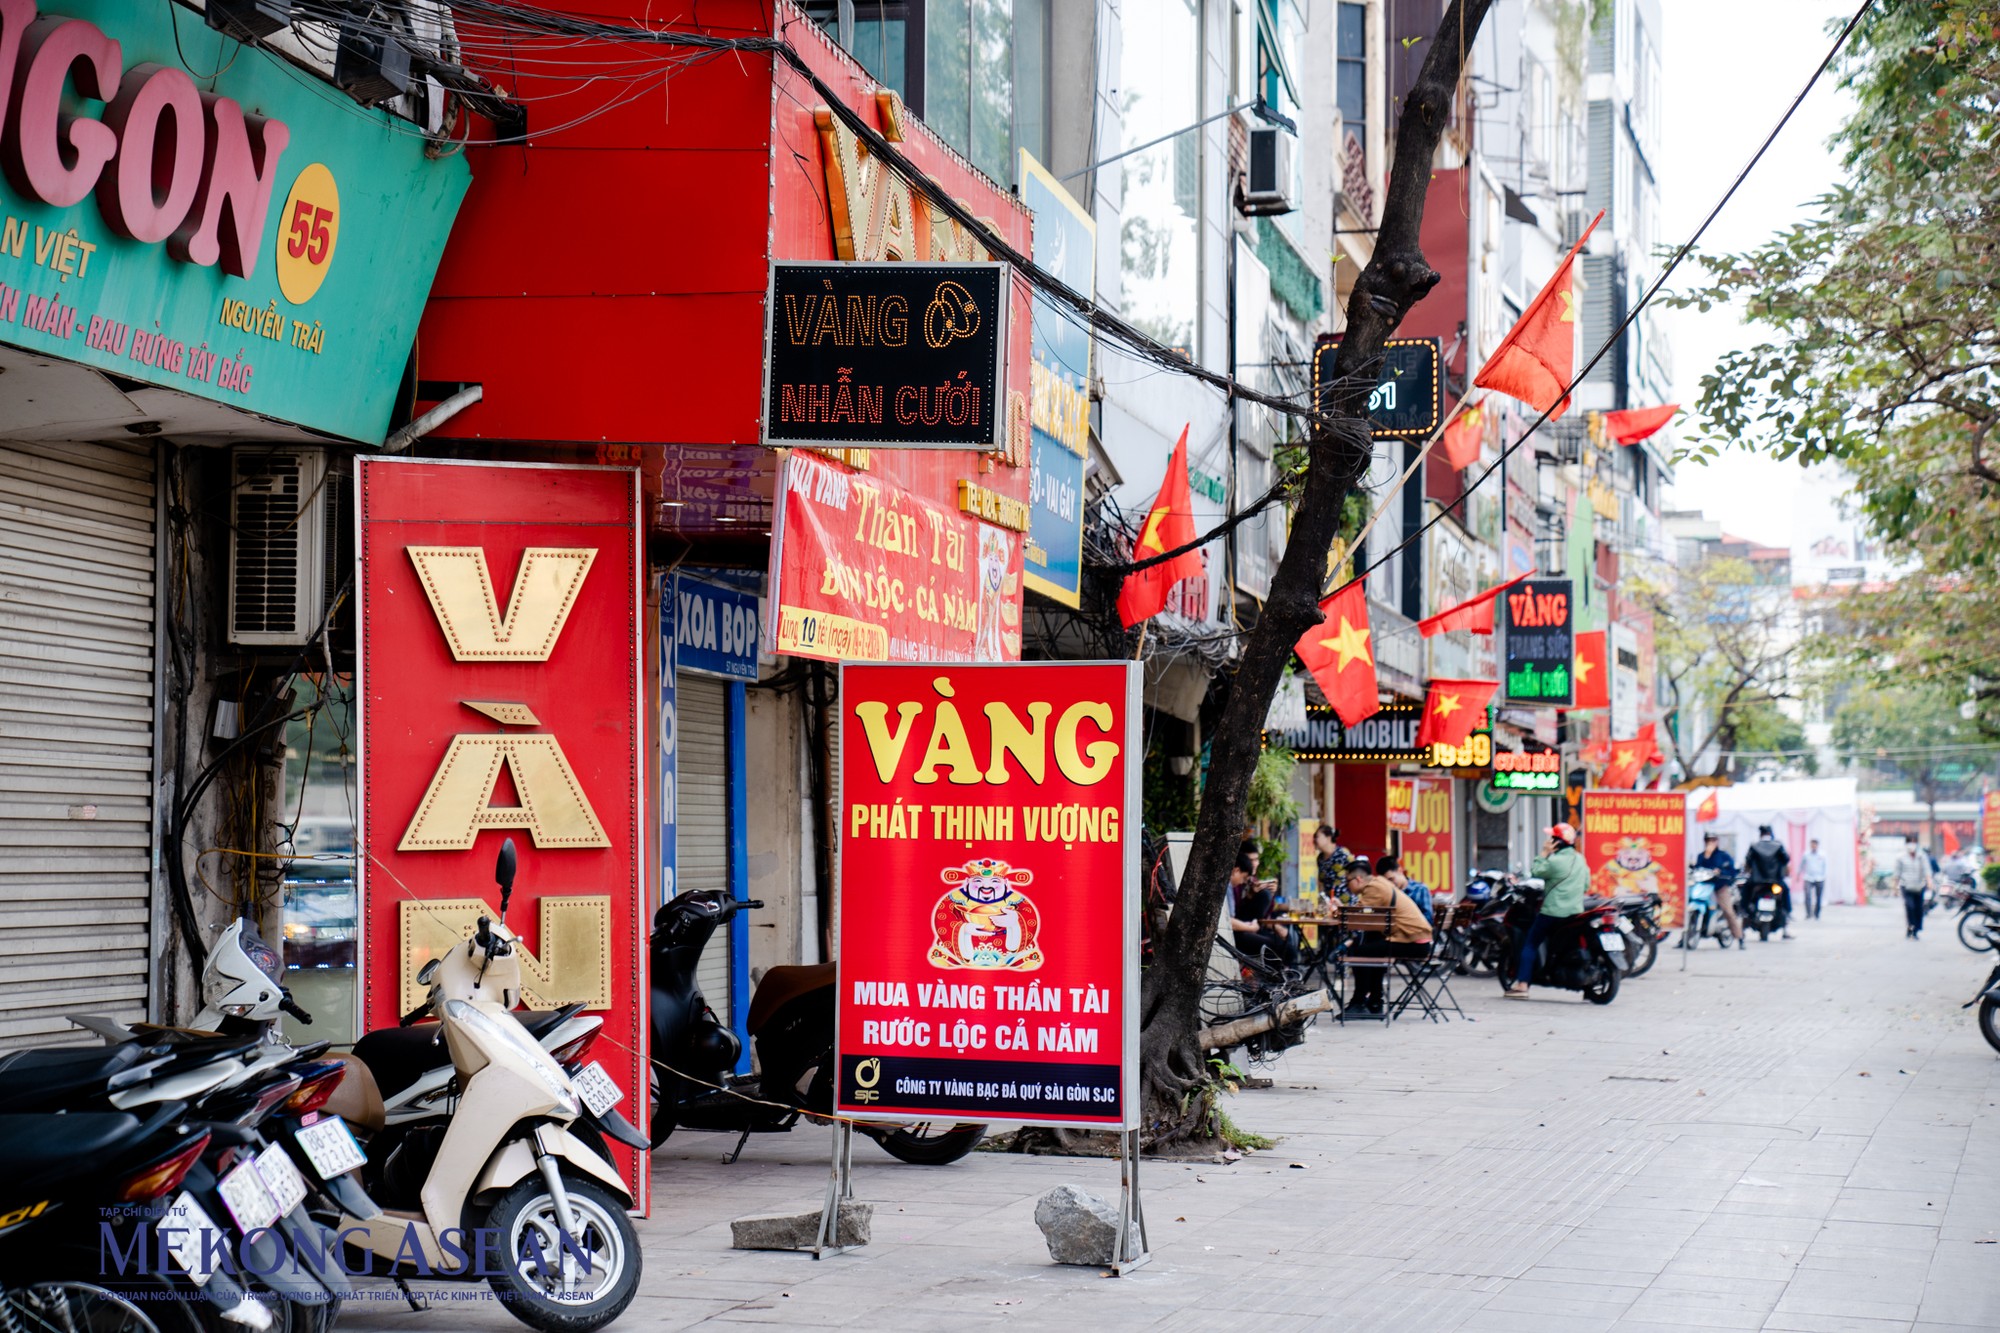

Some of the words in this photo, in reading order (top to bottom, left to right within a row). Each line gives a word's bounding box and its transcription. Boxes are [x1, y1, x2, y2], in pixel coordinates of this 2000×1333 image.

[35, 227, 96, 283] VIỆT
[288, 200, 333, 265] 55
[0, 282, 21, 323] N
[23, 292, 77, 340] MÁN
[85, 314, 129, 354] RAU
[130, 320, 184, 373] RỪNG
[187, 342, 218, 383] TÂY
[217, 349, 253, 394] BẮC
[219, 298, 284, 341] NGUYỄN
[291, 319, 325, 355] TRÃI
[784, 280, 909, 347] VÀNG
[781, 367, 883, 423] NHẪN
[895, 370, 980, 426] CƯỚI
[852, 481, 918, 559] Thần
[925, 505, 966, 573] Tài
[678, 591, 717, 651] XOA
[722, 593, 756, 658] BÓP
[866, 569, 903, 622] LỘC
[916, 582, 940, 624] CẢ
[943, 587, 977, 633] NĂM
[1508, 585, 1568, 627] VÀNG
[802, 617, 817, 643] 10
[855, 676, 1120, 786] VÀNG
[1427, 733, 1491, 768] 999
[851, 797, 923, 839] PHÁT
[931, 805, 1014, 848] THỊNH
[1023, 803, 1119, 850] VƯỢNG
[1658, 816, 1683, 835] LAN
[1403, 836, 1449, 891] HỎI
[854, 981, 910, 1007] MUA
[916, 979, 985, 1010] VÀNG
[994, 979, 1065, 1013] THẦN
[1069, 983, 1109, 1014] TÀI
[863, 1018, 931, 1046] RƯỚC
[939, 1018, 989, 1054] LỘC
[995, 1018, 1029, 1051] CẢ
[1037, 1021, 1098, 1053] NĂM
[895, 1076, 926, 1095] CÔNG
[928, 1080, 941, 1095] TY
[943, 1079, 974, 1097] VÀNG
[976, 1081, 999, 1101] BẠC
[1001, 1080, 1017, 1098] ĐÁ
[1019, 1080, 1041, 1100] QUÝ
[1044, 1081, 1063, 1101] SÀI
[1066, 1082, 1090, 1102] GÒN
[1092, 1087, 1115, 1103] SJC
